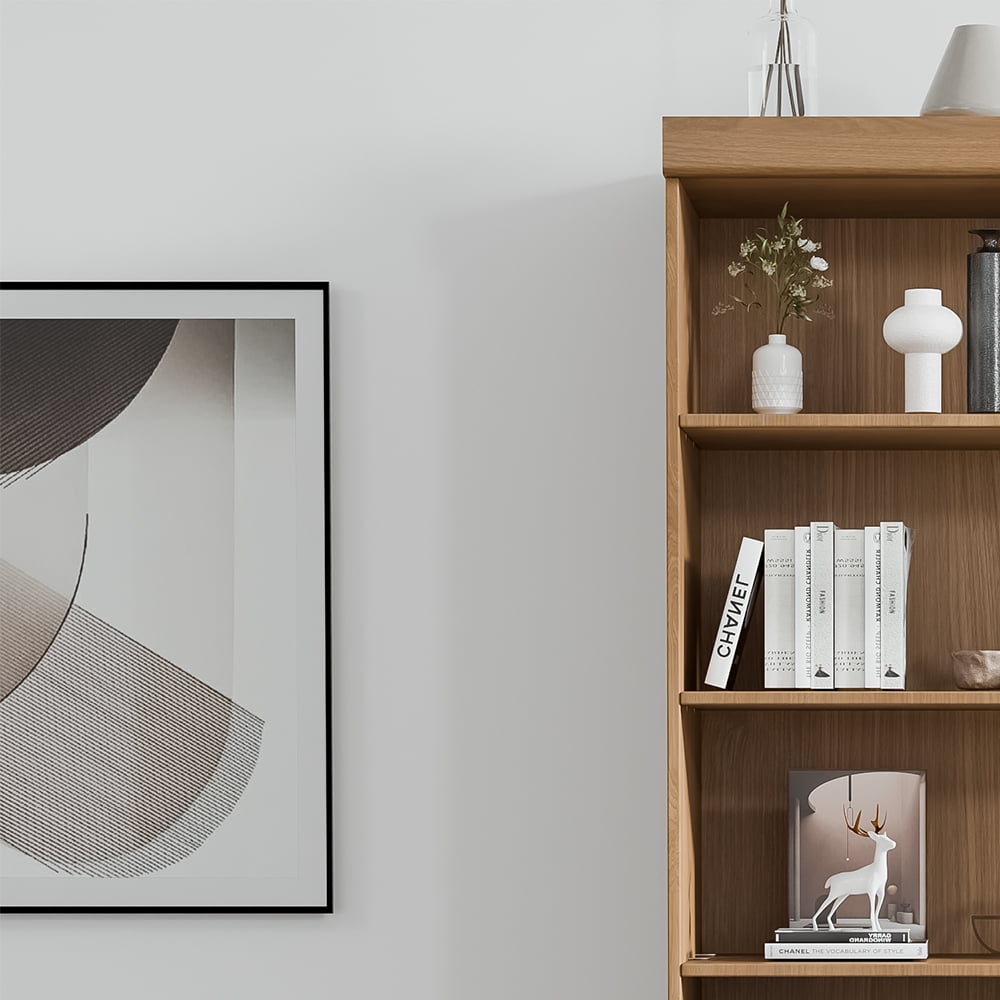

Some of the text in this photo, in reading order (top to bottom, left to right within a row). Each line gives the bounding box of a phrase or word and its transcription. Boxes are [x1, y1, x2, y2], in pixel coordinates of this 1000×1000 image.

[816, 525, 830, 543] Dior
[886, 525, 900, 543] Dior
[888, 590, 896, 615] FASHION
